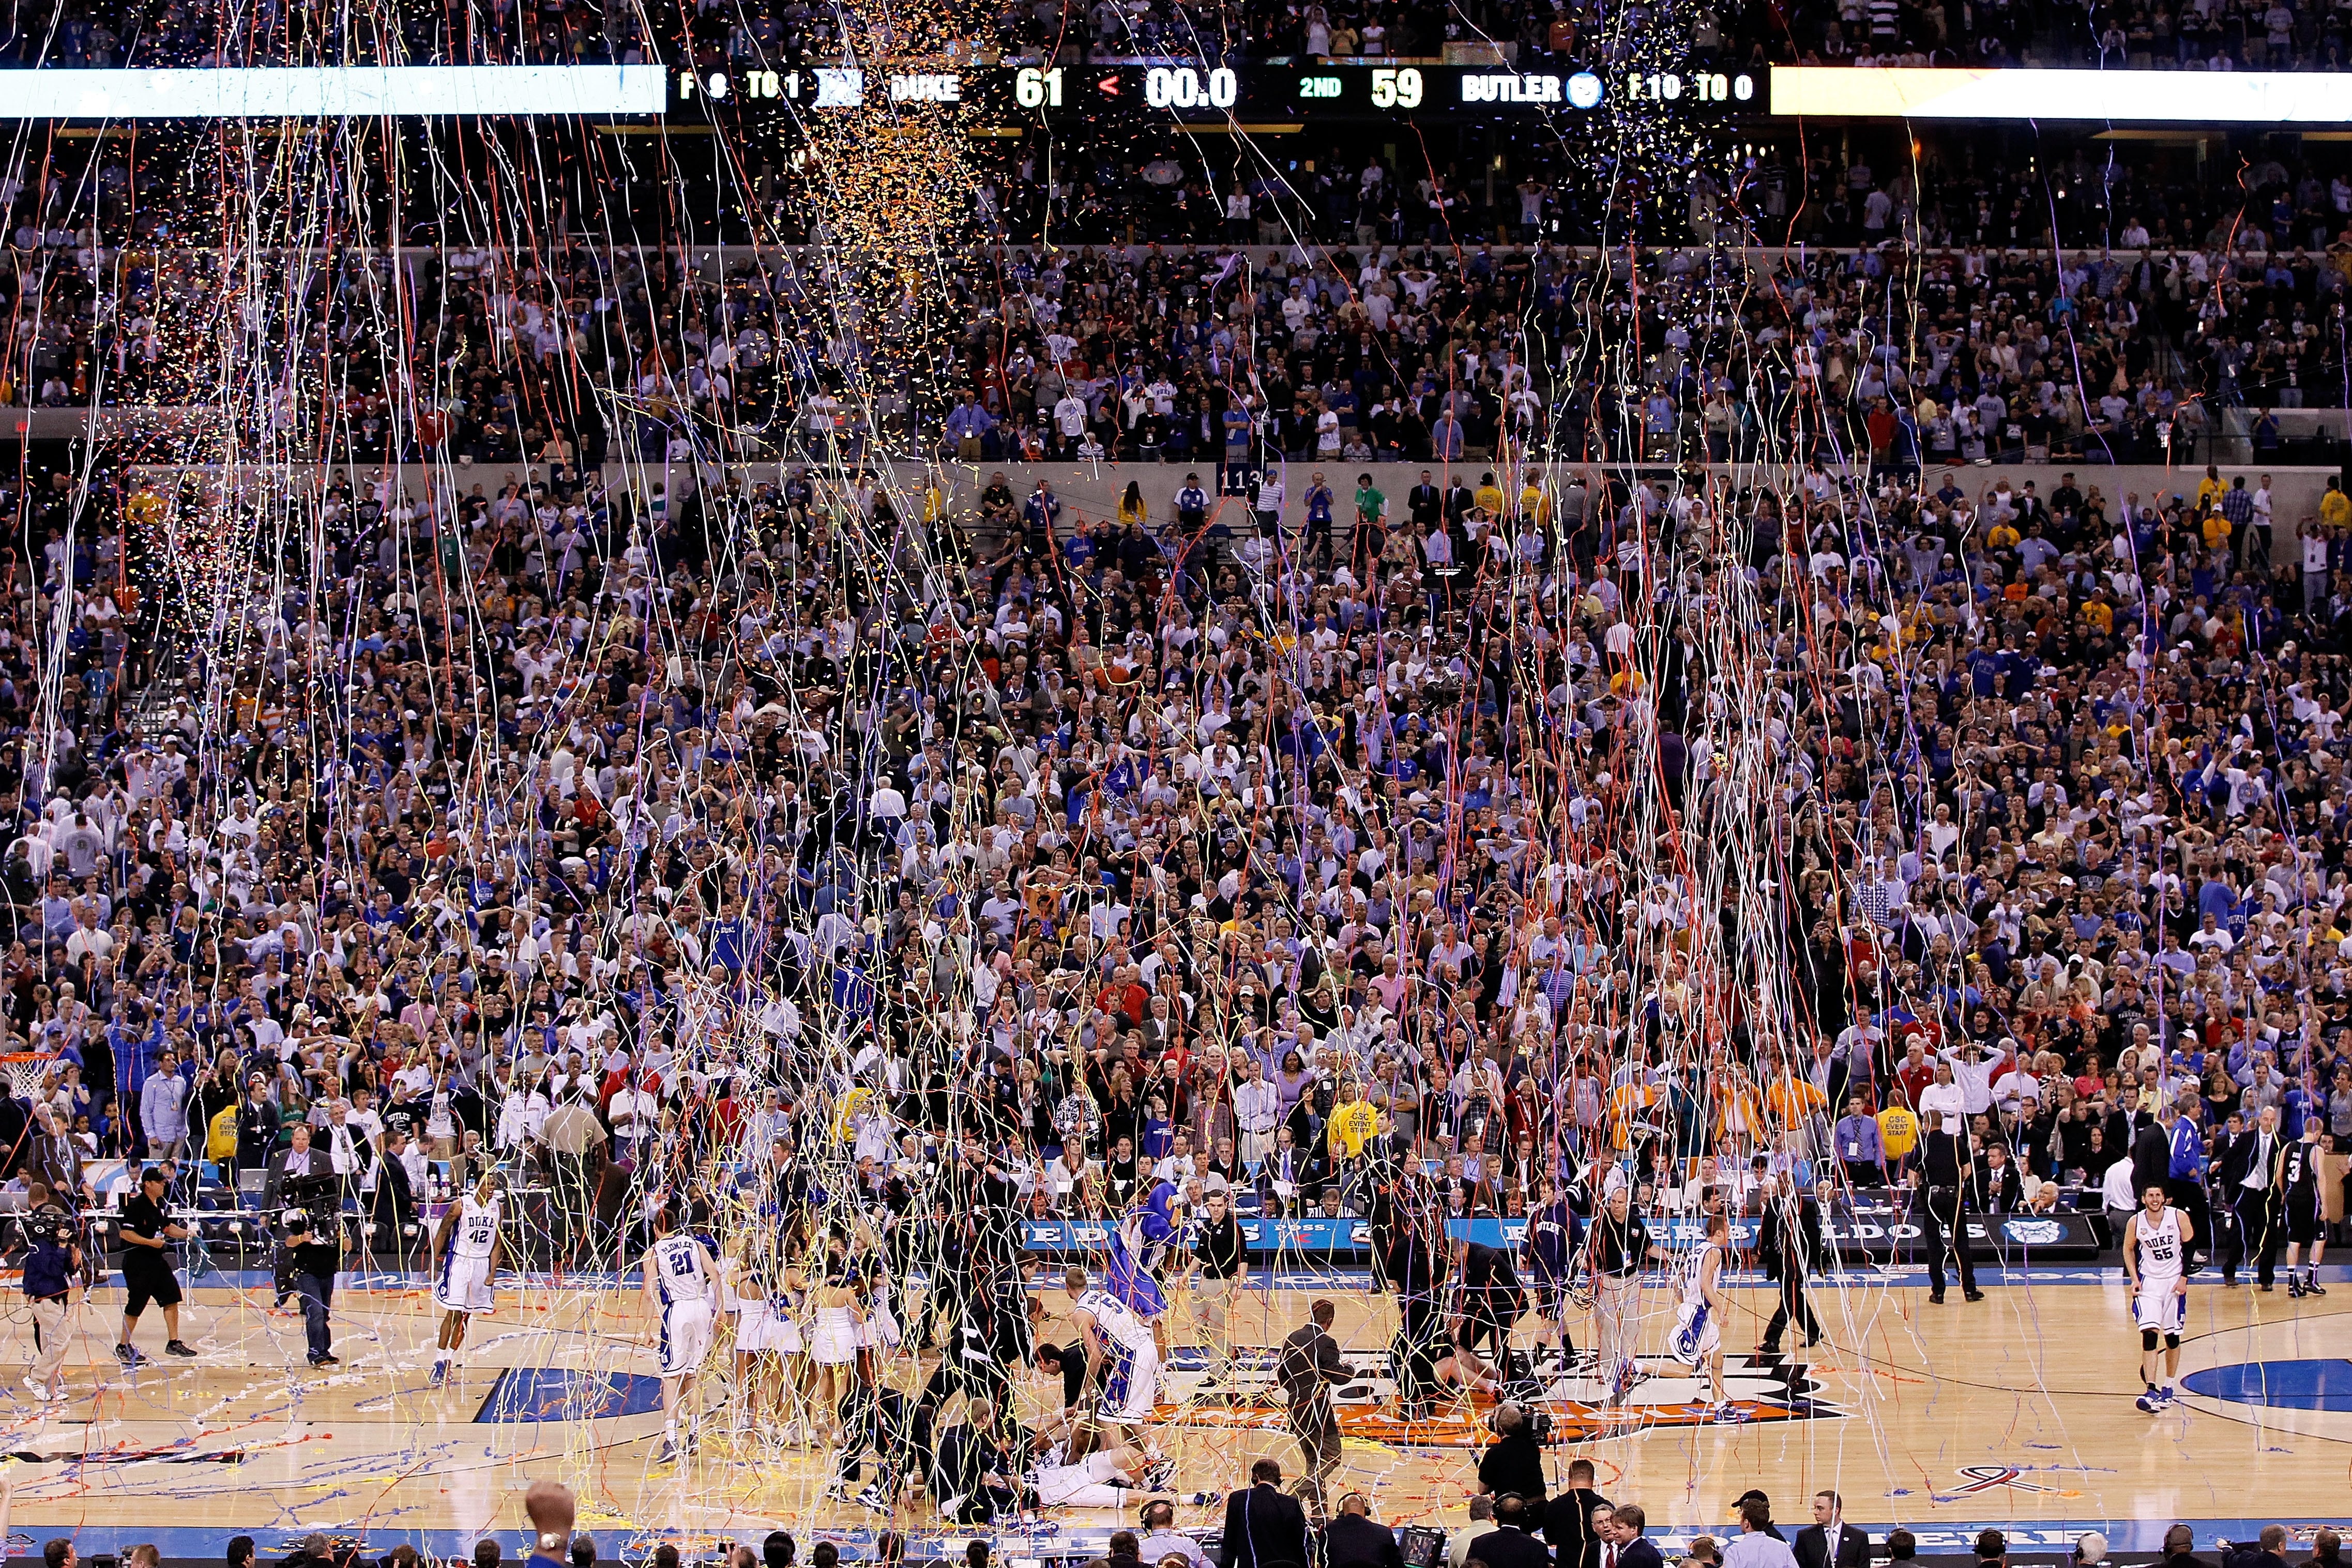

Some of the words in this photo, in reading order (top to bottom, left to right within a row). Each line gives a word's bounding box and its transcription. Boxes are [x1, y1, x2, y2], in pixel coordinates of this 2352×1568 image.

[680, 72, 694, 99] F
[746, 71, 778, 98] TO
[784, 72, 798, 99] 1
[891, 74, 961, 102] DUKE
[1016, 68, 1063, 107] 61
[1146, 68, 1238, 107] 00.0
[1300, 78, 1342, 98] 2ND
[1371, 68, 1422, 109] 59
[1462, 74, 1560, 102] BUTLER
[1647, 74, 1681, 100] 10
[1696, 74, 1727, 100] TO
[1734, 75, 1753, 100] 0
[1807, 261, 1846, 278] 24
[1876, 472, 1916, 490] 14
[387, 1112, 411, 1122] BUTLER
[468, 1216, 494, 1228] DUKE
[468, 1230, 489, 1243] 42
[2145, 1235, 2173, 1248] DUKE
[669, 1250, 694, 1276] 21
[2152, 1247, 2174, 1260] 55
[1102, 1297, 1123, 1314] 5
